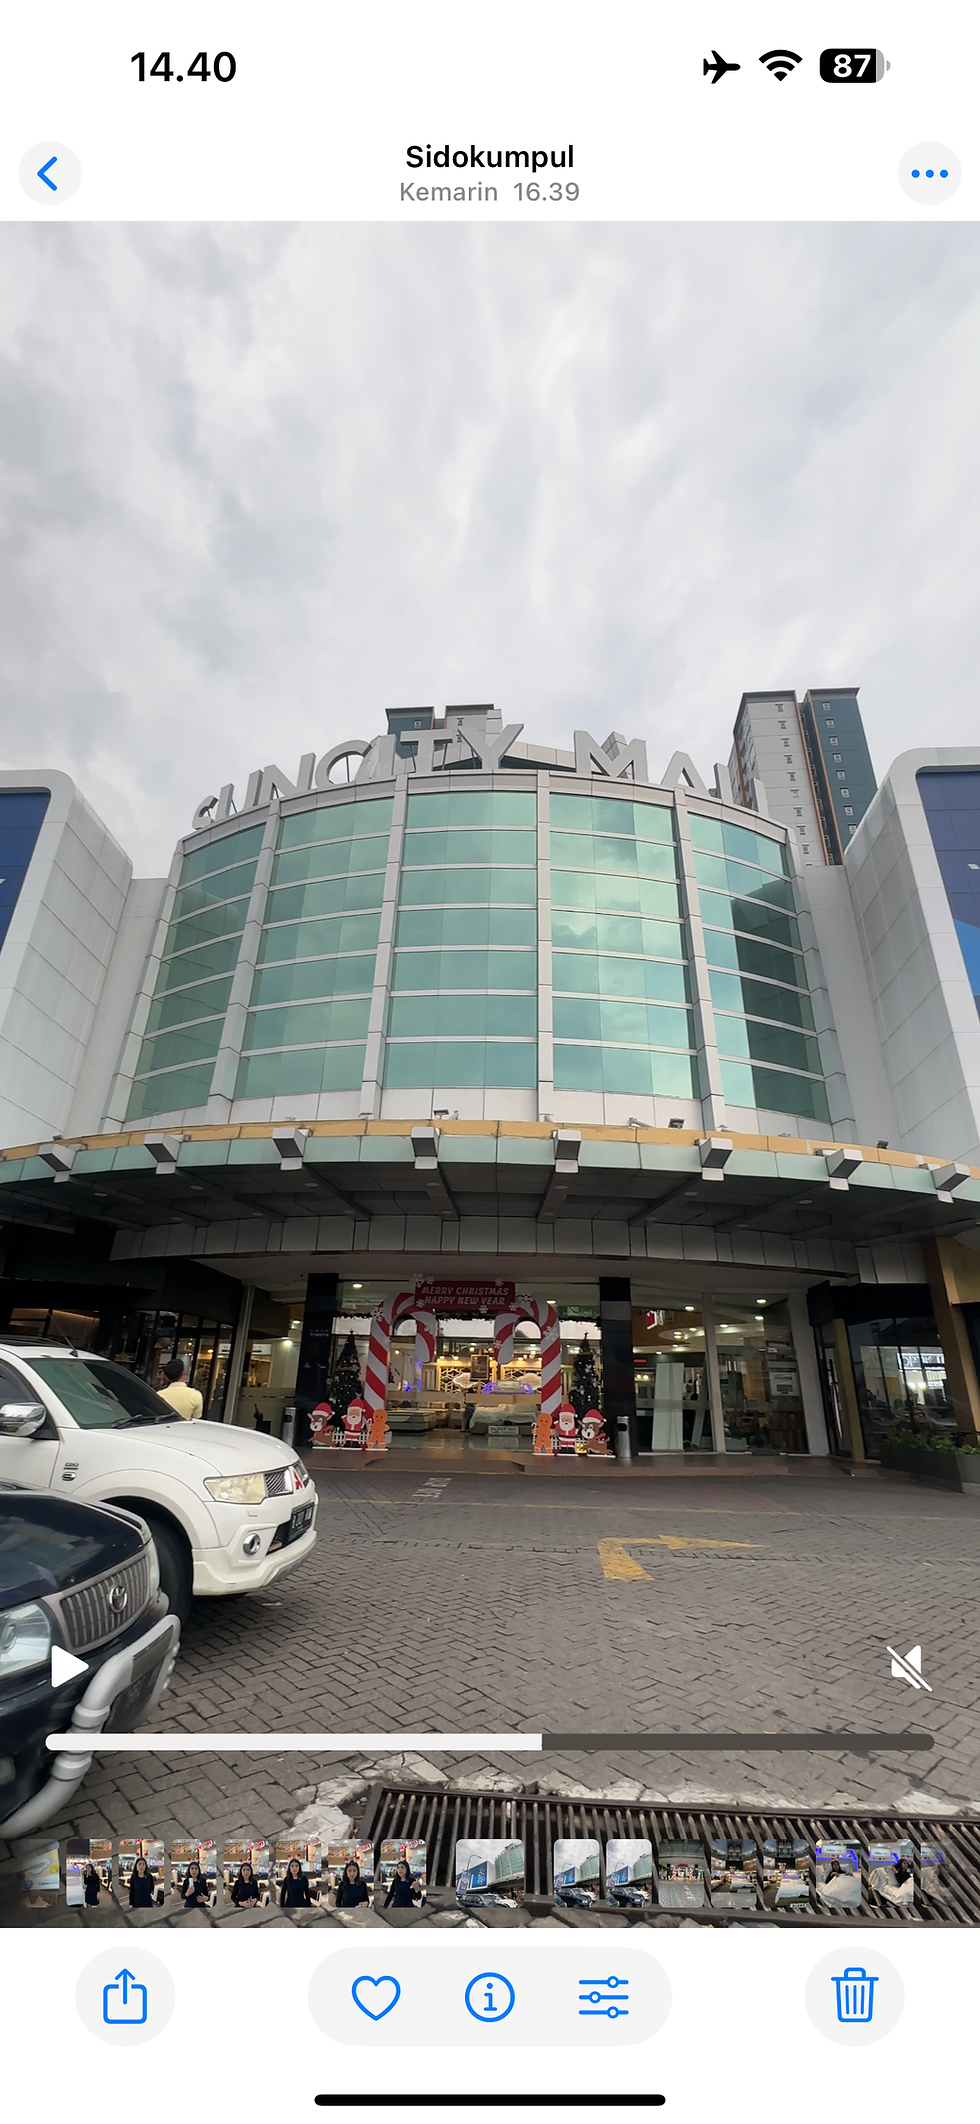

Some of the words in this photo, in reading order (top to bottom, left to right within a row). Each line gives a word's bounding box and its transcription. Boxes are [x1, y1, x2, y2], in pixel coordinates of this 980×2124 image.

[421, 1286, 454, 1295] MERRY
[456, 1287, 509, 1295] CHRISTMAS
[424, 1296, 456, 1304] HAPPY
[457, 1296, 479, 1305] NEW
[481, 1297, 506, 1305] YEAR
